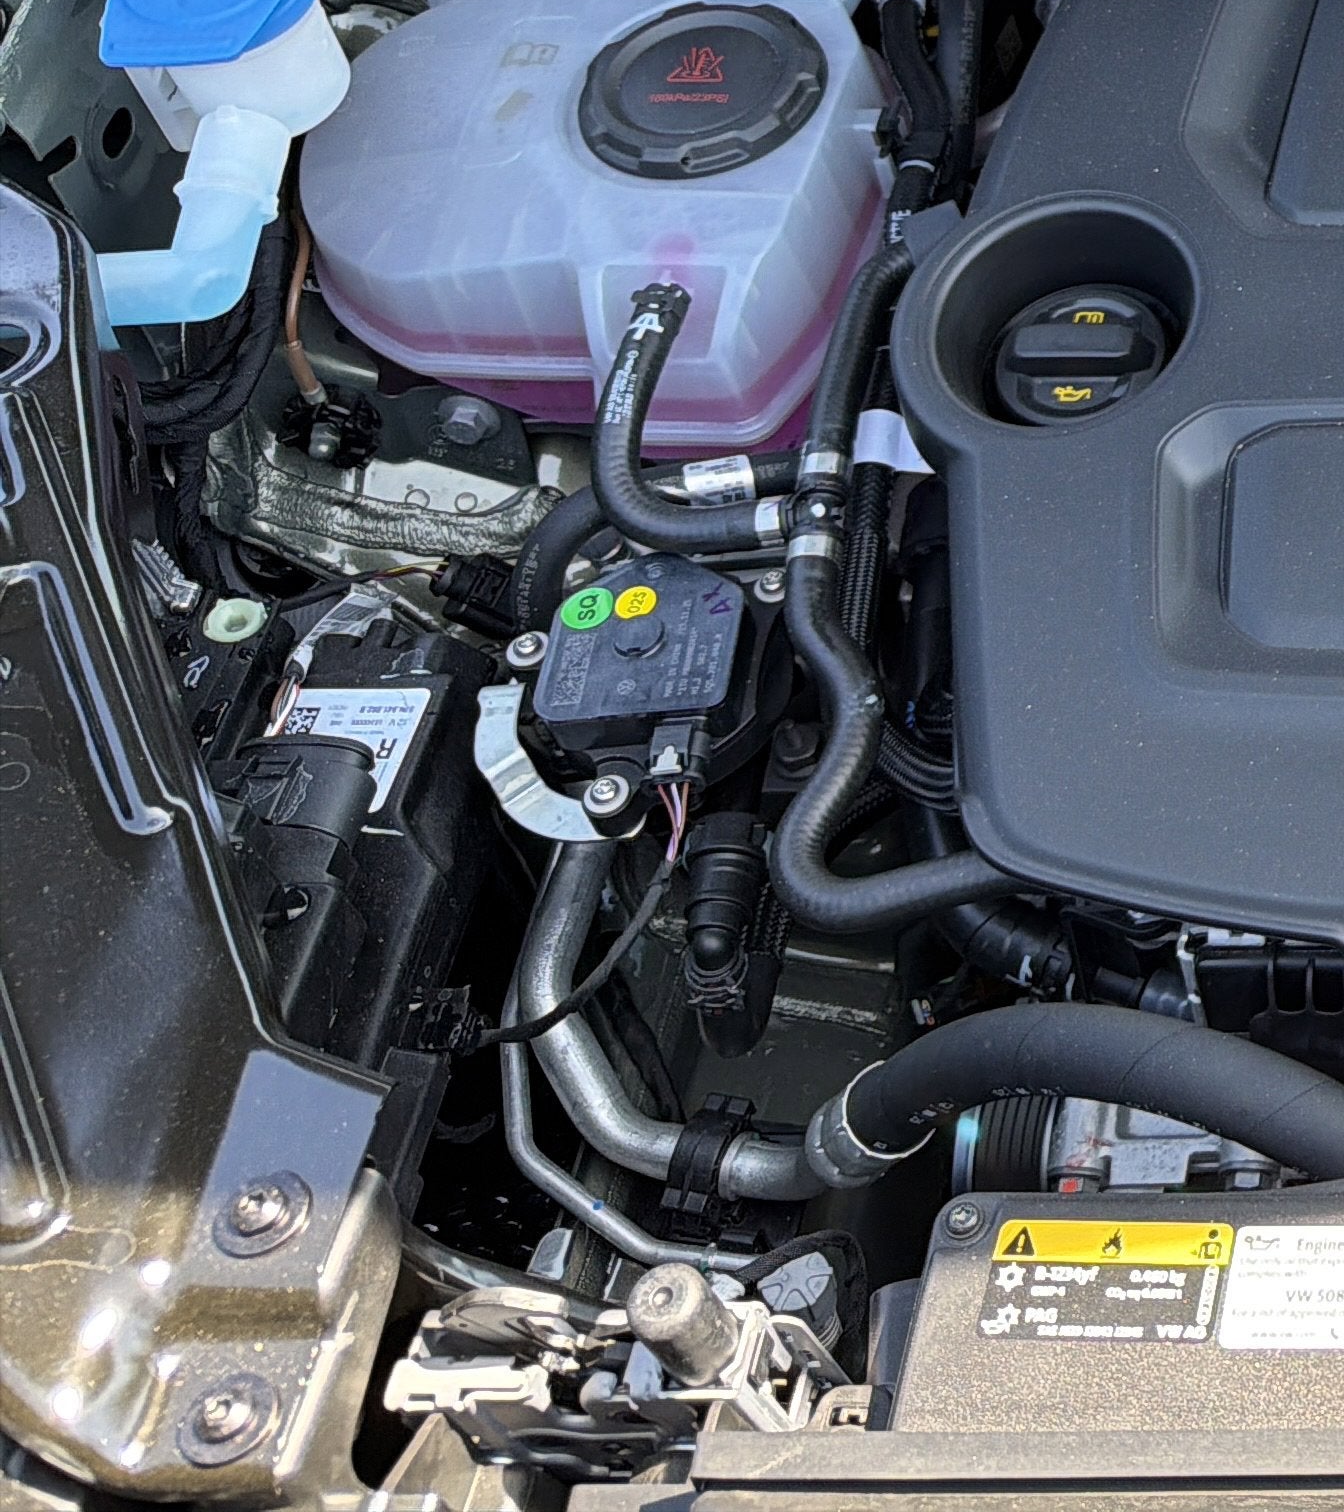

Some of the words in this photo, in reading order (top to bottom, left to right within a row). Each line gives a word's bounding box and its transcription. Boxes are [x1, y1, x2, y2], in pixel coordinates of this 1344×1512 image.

[577, 592, 601, 623] SQ
[375, 737, 398, 760] R
[1286, 1289, 1314, 1303] VW
[1024, 1307, 1059, 1324] PAG
[1155, 1324, 1182, 1339] VW
[1183, 1324, 1208, 1339] AG
